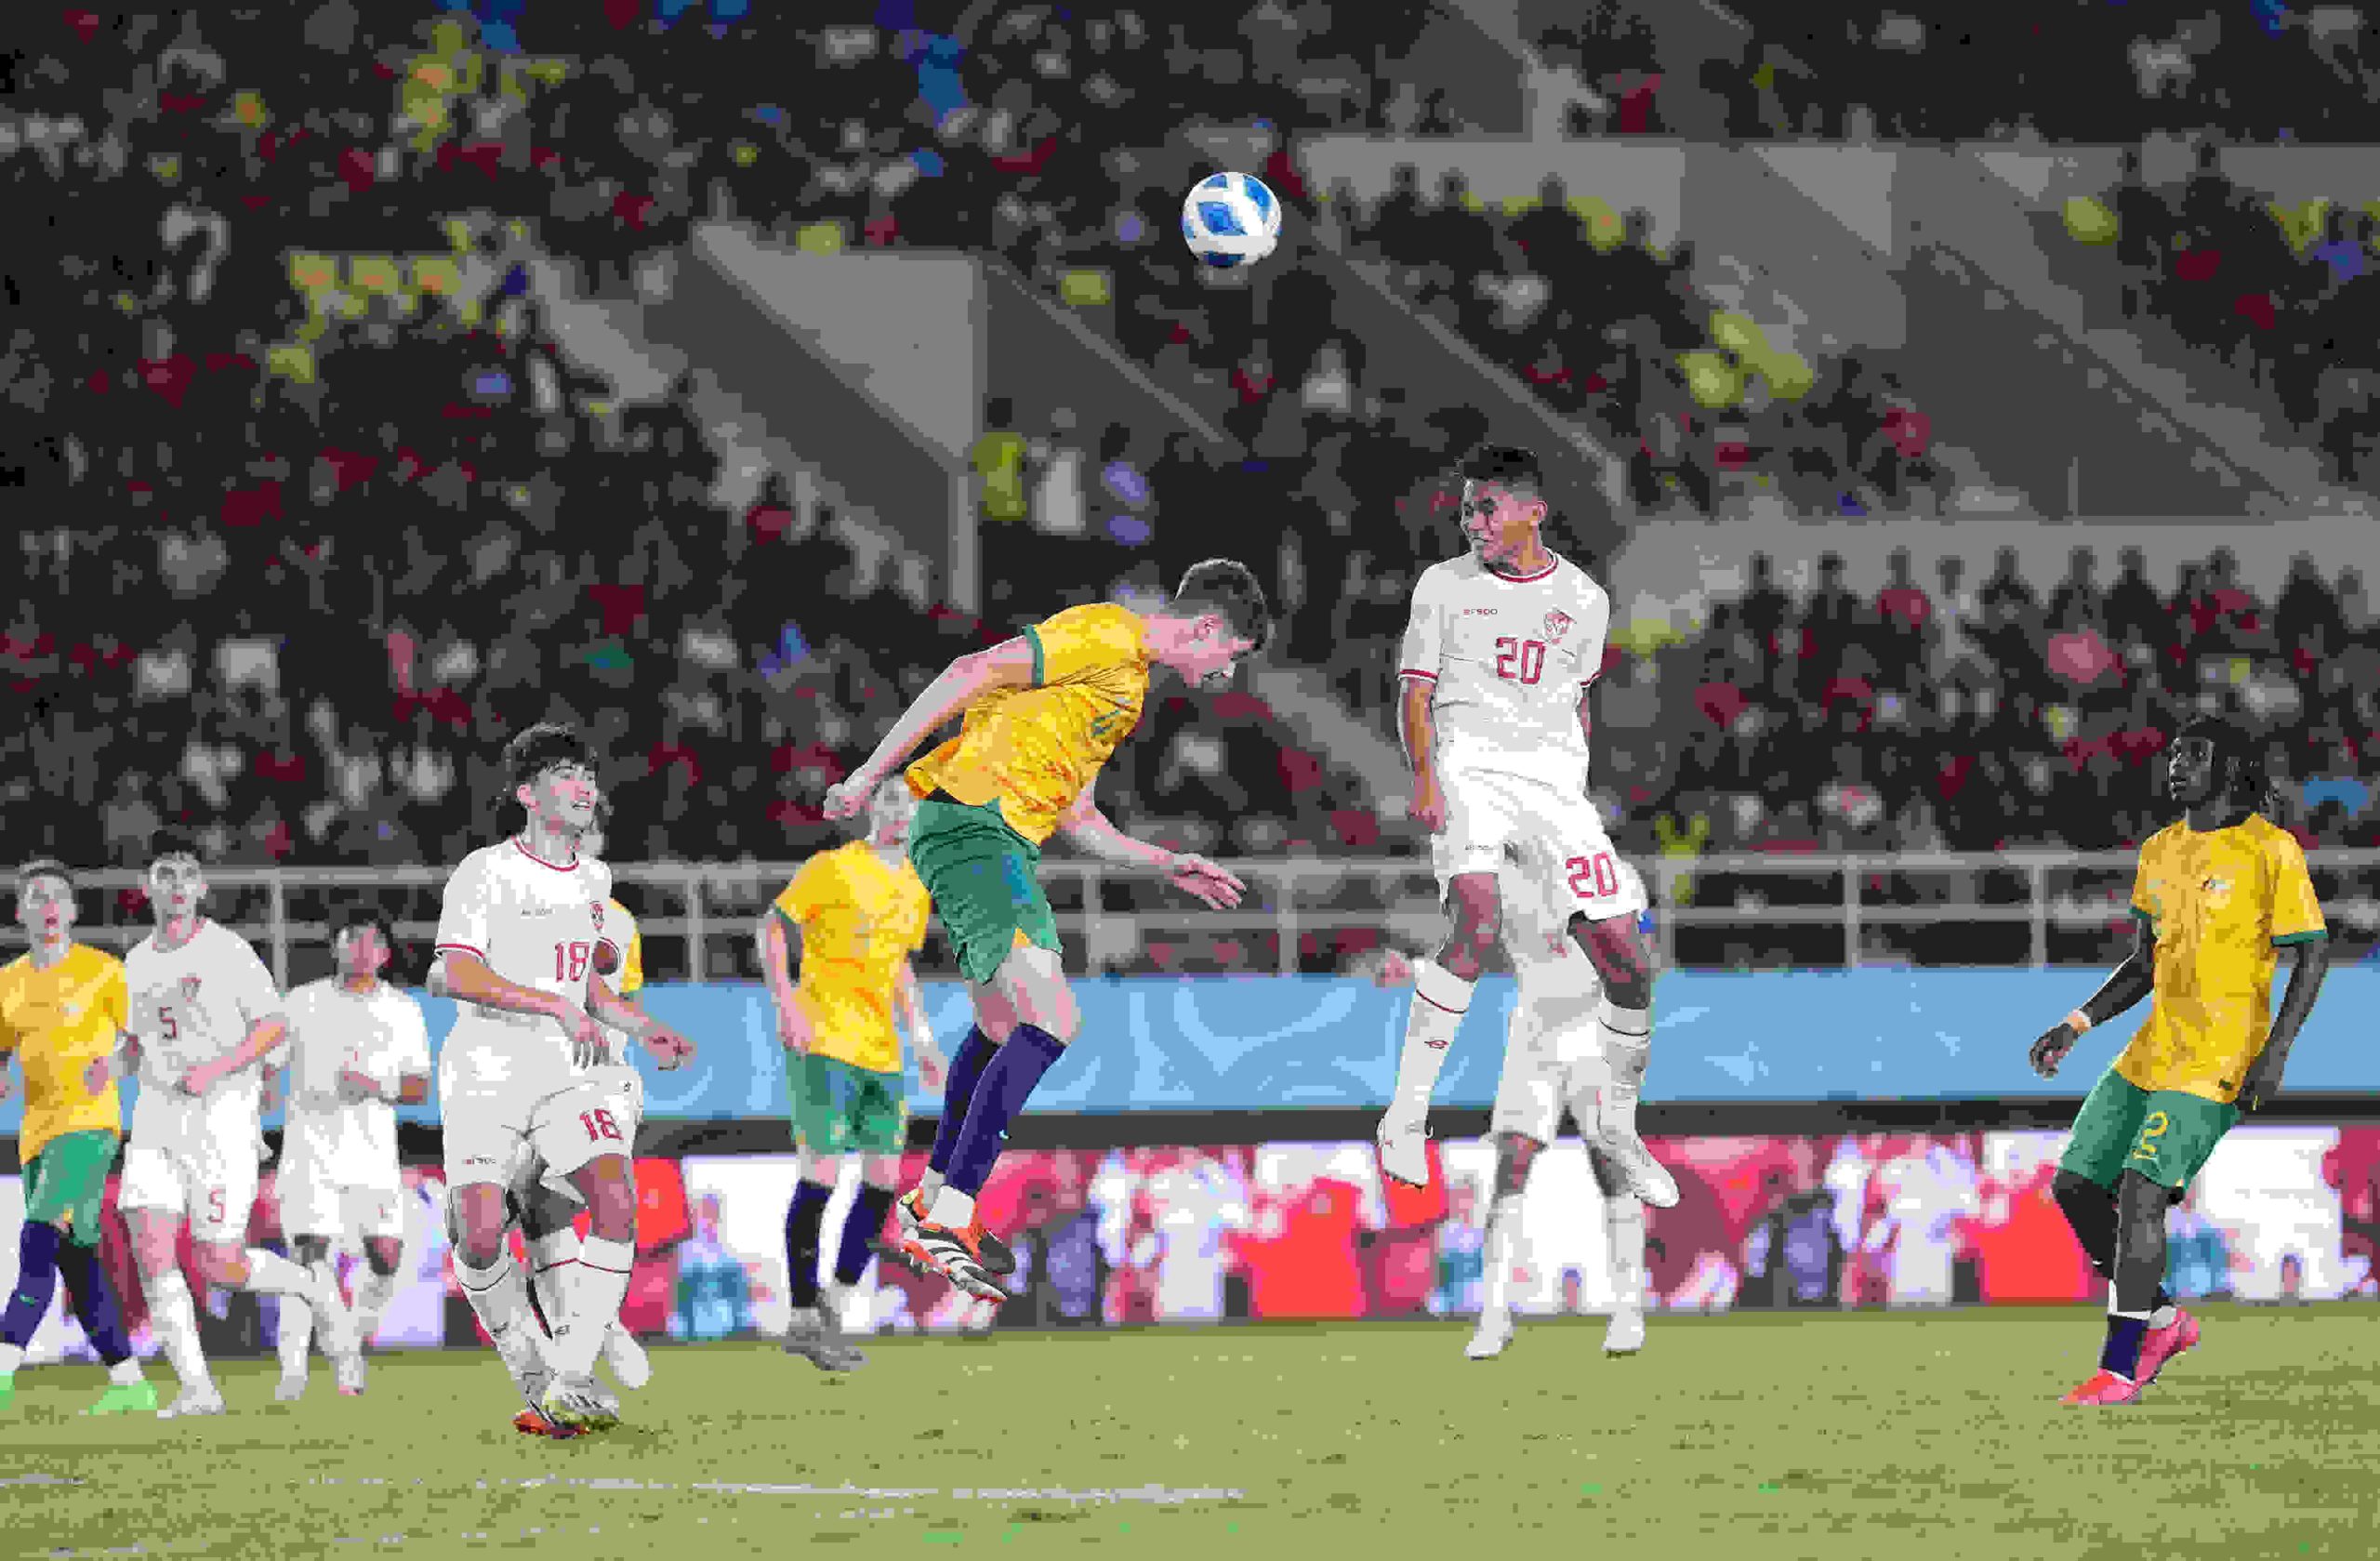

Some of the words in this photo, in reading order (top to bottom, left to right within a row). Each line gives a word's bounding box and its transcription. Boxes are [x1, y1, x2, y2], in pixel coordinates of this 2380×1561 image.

[1495, 637, 1545, 684] 20
[1566, 853, 1618, 897] 20
[555, 942, 590, 982] 18
[158, 1006, 177, 1039] 5
[2132, 1110, 2169, 1160] 2
[208, 1188, 226, 1224] 5
